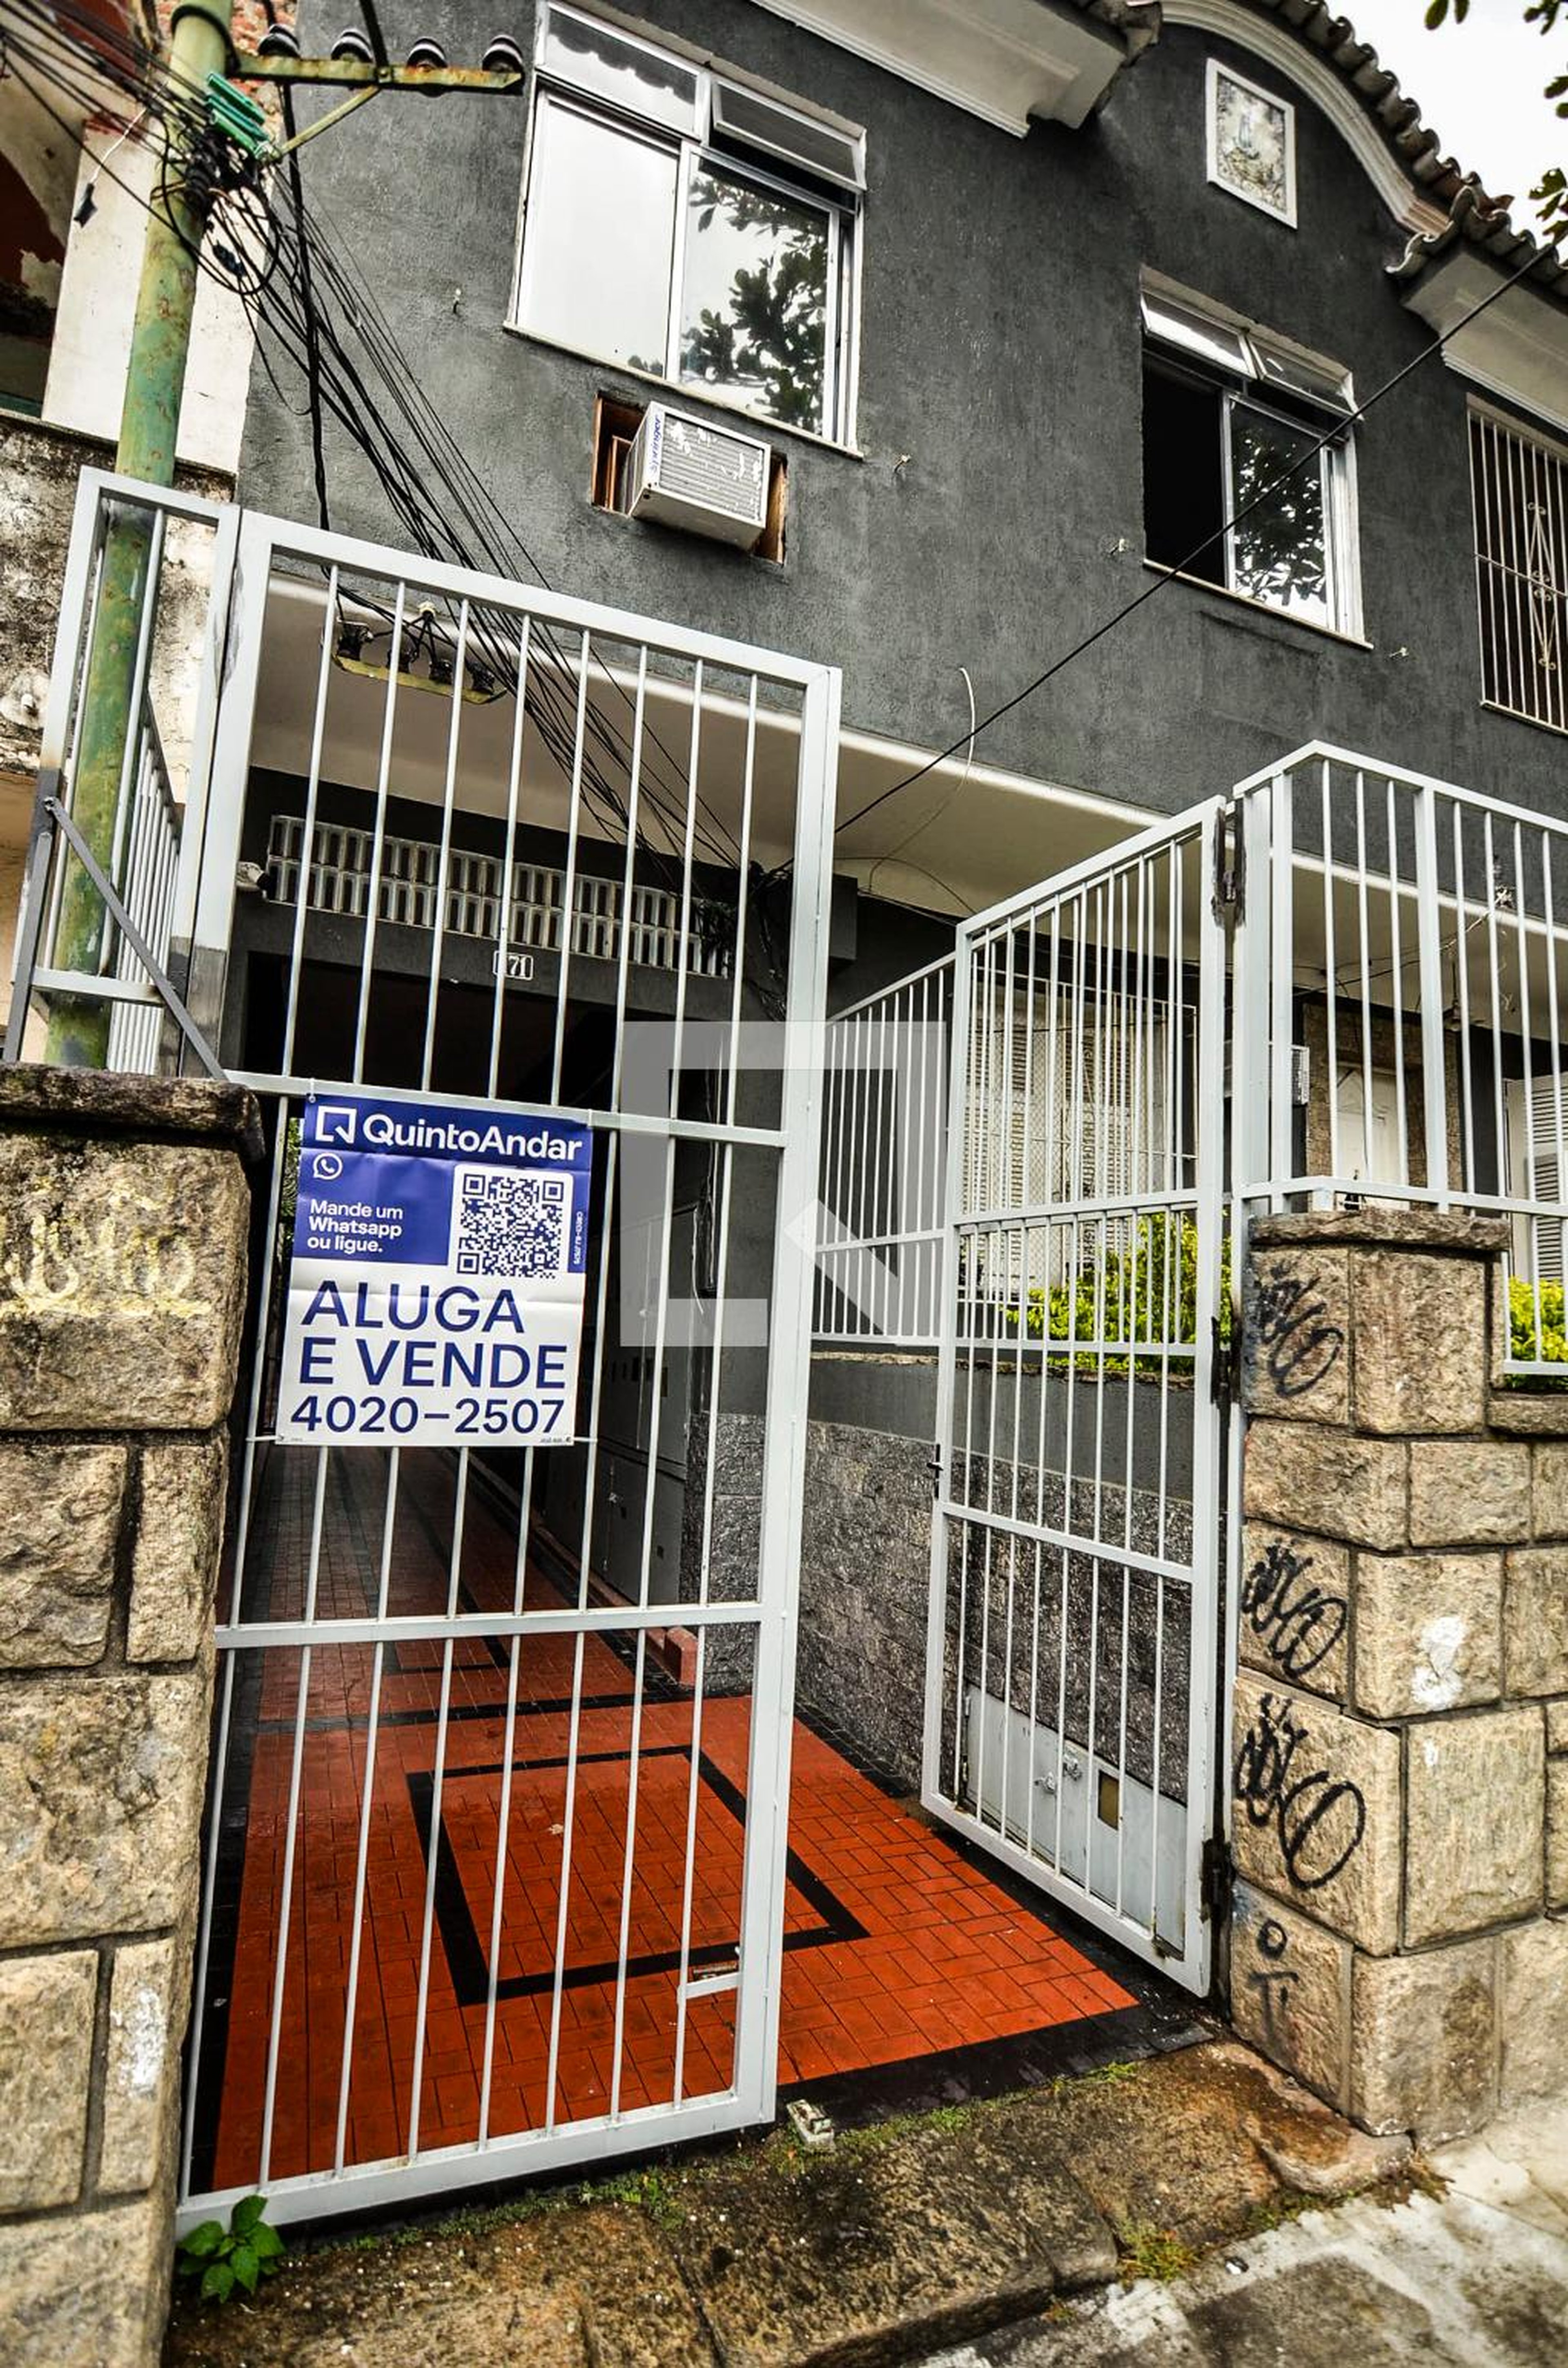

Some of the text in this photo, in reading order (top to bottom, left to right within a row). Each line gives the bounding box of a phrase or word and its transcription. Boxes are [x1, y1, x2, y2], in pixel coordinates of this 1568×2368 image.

[363, 1114, 583, 1161] QuintoAndar
[309, 1216, 402, 1239] Whatsapp
[310, 1199, 403, 1220] Mande um
[307, 1235, 383, 1254] ou ligue.
[300, 1280, 525, 1333] ALUGA
[300, 1337, 567, 1389] E VENDE
[291, 1396, 565, 1433] 4020-2507
